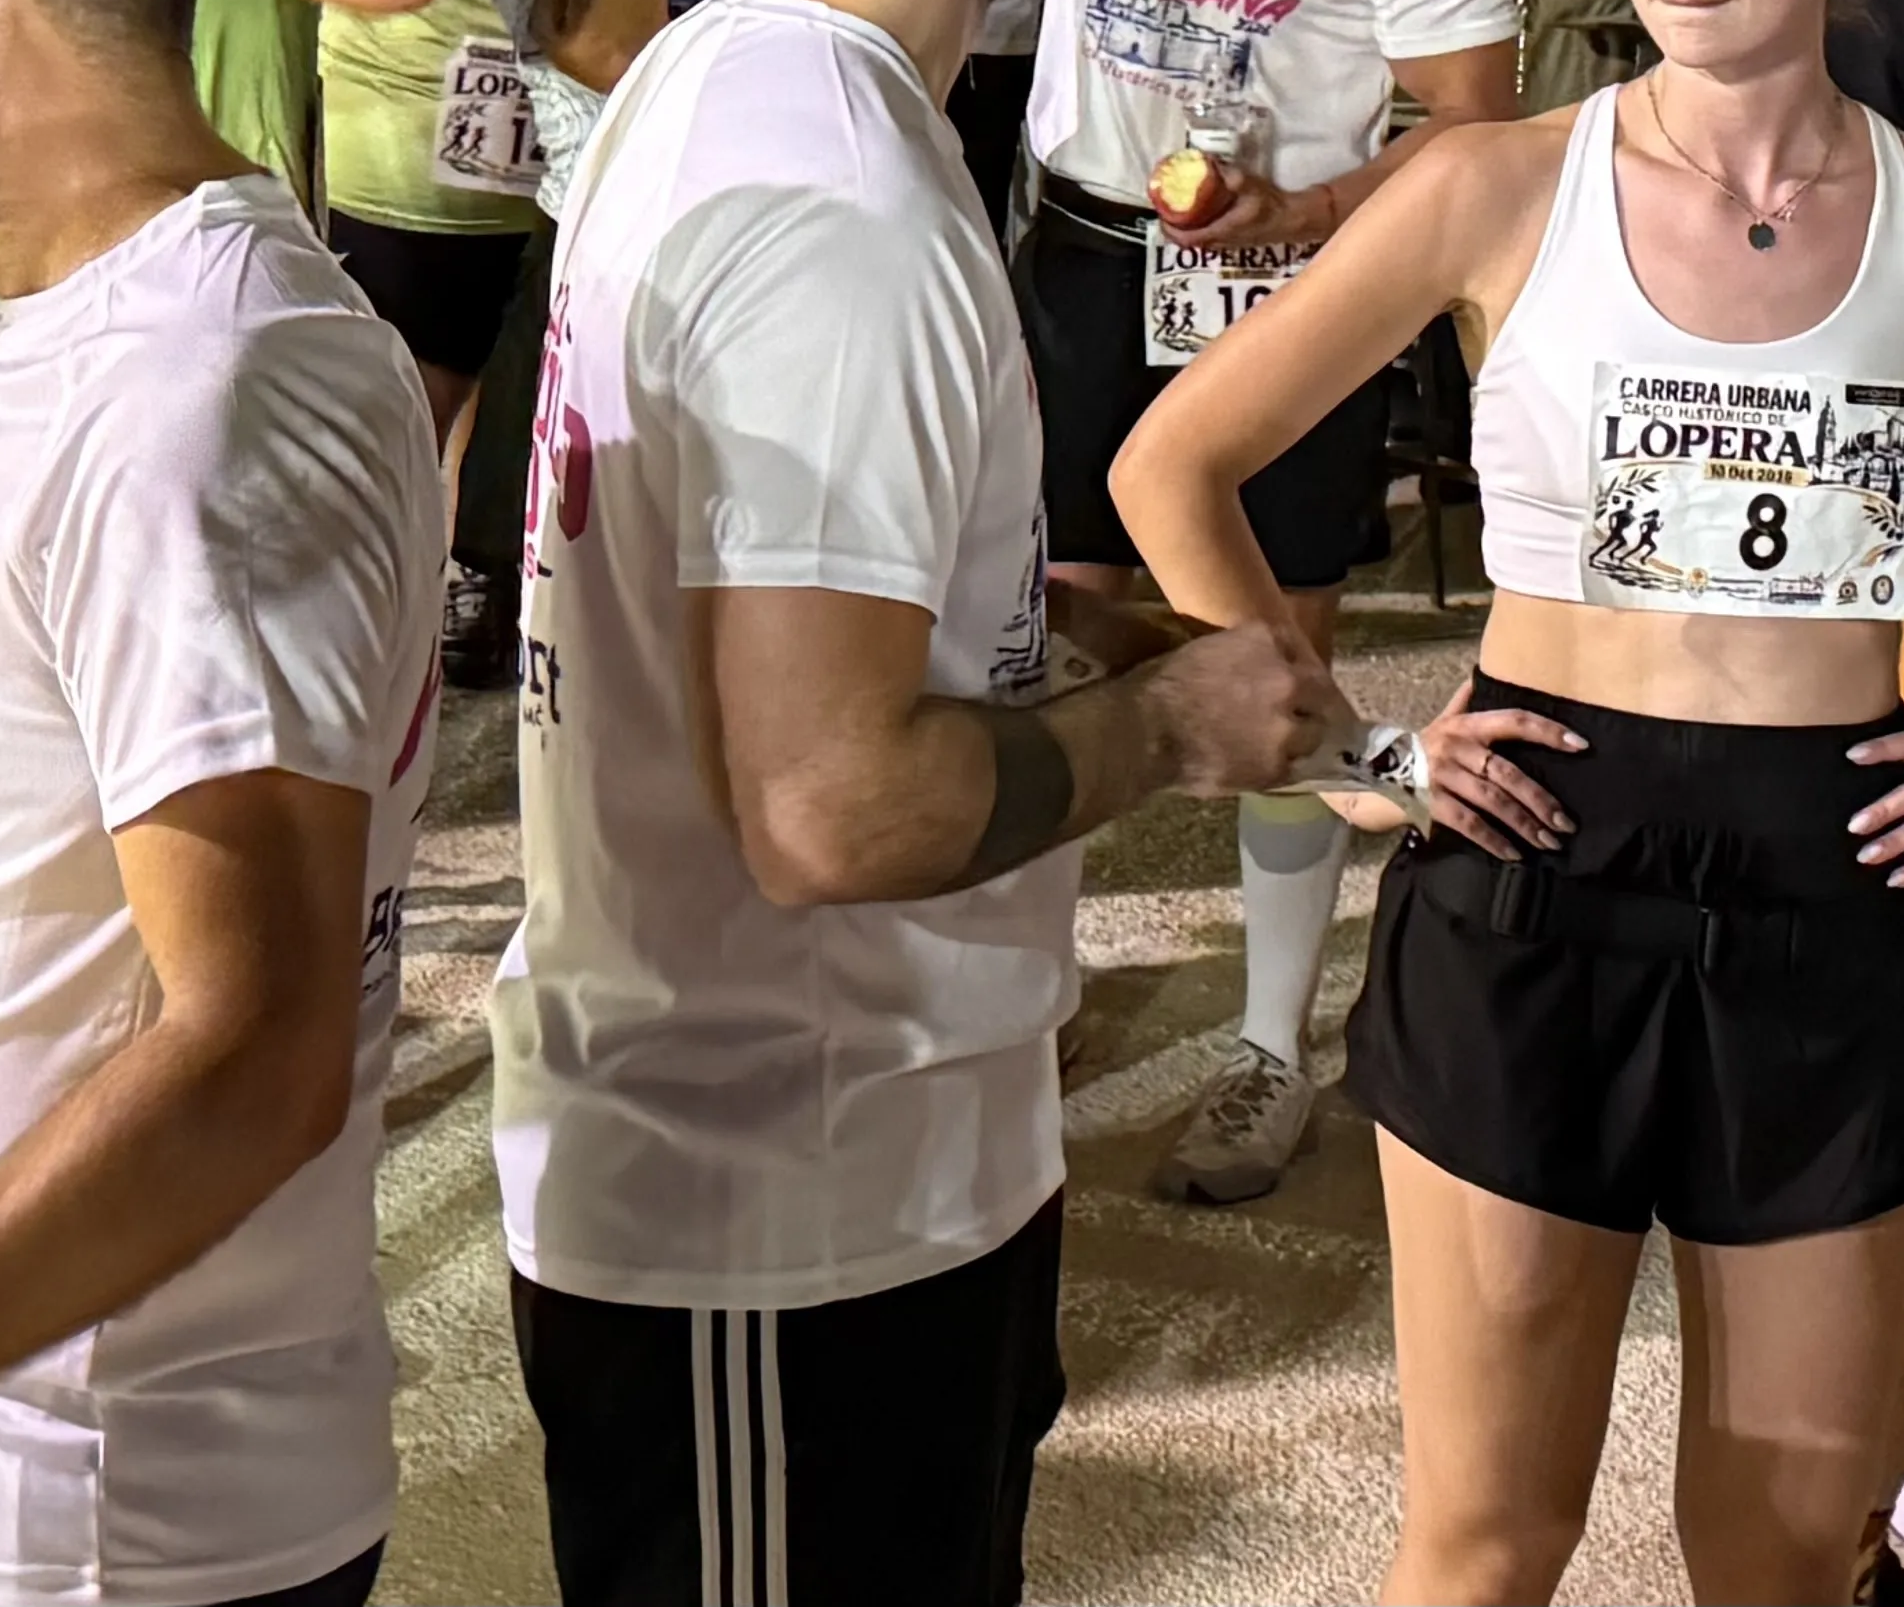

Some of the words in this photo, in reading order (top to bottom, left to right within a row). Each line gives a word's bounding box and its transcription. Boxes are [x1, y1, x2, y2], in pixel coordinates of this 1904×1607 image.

[1154, 244, 1283, 274] LOPERA
[1620, 377, 1721, 405] CARRERA
[1728, 384, 1812, 414] URBANA
[1601, 415, 1810, 469] LOPERA
[1738, 492, 1788, 571] 8
